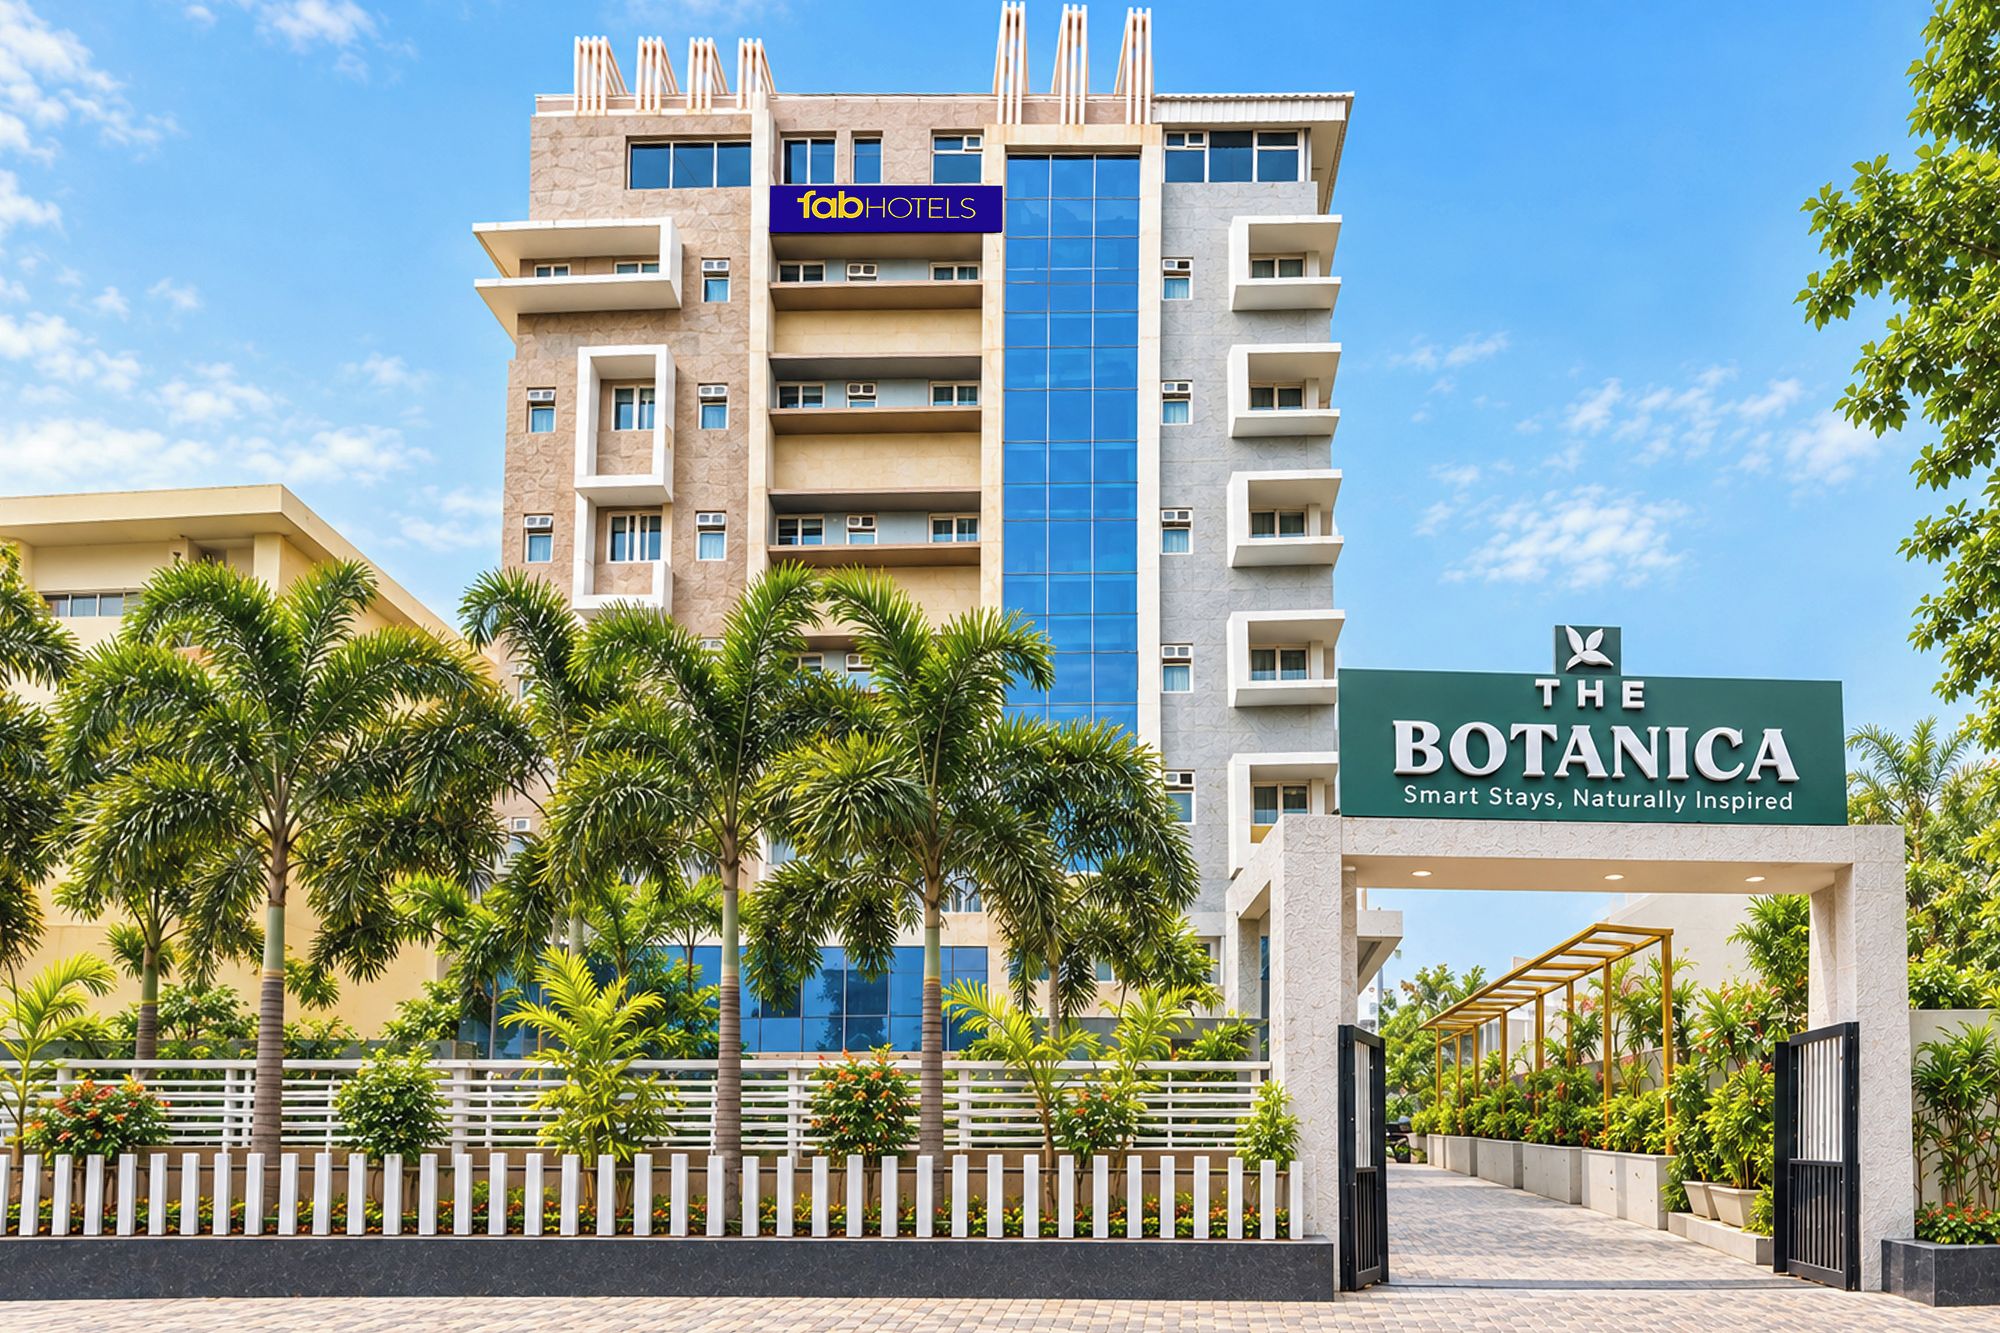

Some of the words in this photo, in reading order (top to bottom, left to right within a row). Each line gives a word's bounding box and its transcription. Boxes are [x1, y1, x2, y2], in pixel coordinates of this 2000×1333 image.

[1535, 678, 1648, 708] THE
[1392, 719, 1801, 783] BOTANICA
[1403, 784, 1479, 805] Smart
[1489, 786, 1563, 811] Stays,
[1573, 788, 1686, 813] Naturally
[1696, 790, 1793, 814] Inspired
